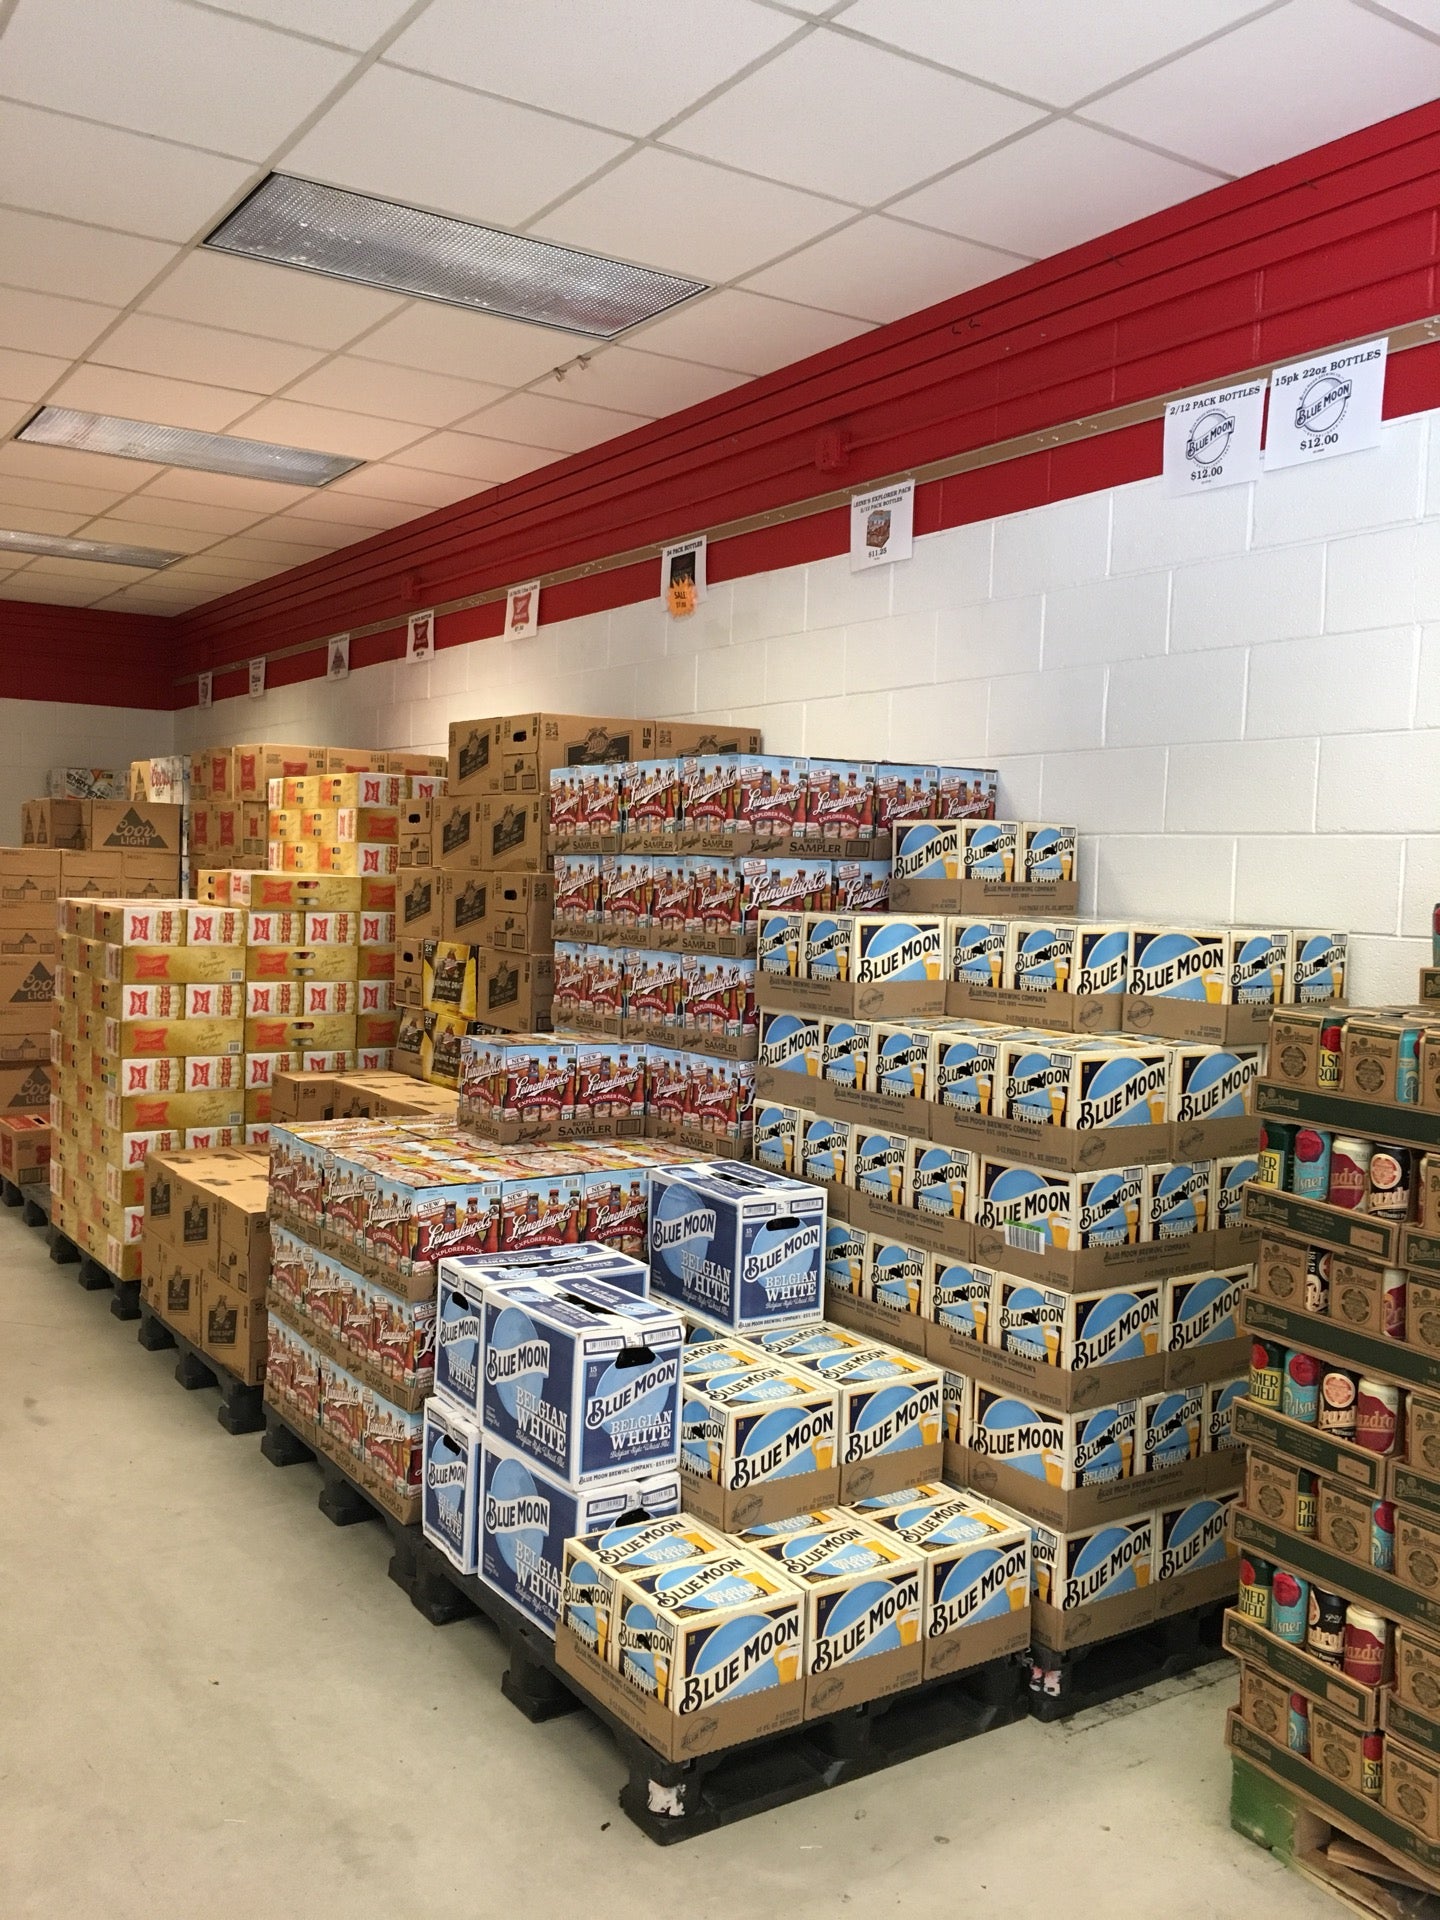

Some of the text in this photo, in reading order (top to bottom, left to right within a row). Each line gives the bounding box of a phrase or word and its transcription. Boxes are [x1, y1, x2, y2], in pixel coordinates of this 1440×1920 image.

[1275, 373, 1299, 387] 15pk
[1302, 365, 1327, 380] 22oz
[1330, 349, 1381, 371] BOTTLES
[1169, 386, 1261, 415] 2/12 PACK BOTTLES
[1296, 403, 1322, 427] BLUE
[1323, 383, 1350, 409] MOON
[1187, 420, 1234, 459] BLUE MOON
[1300, 433, 1339, 451] $12.00
[1190, 466, 1223, 481] $12.00
[870, 502, 882, 510] PACK
[882, 496, 902, 506] BOTTLES
[872, 492, 898, 503] EXPLORER
[898, 486, 912, 496] PACK
[674, 590, 687, 600] SALE
[546, 728, 559, 736] 24
[744, 785, 800, 812] Leinenkugel's
[113, 818, 158, 837] Coors
[750, 812, 792, 822] EXPLORER PACK
[120, 836, 151, 846] LIGHT
[643, 840, 673, 849] SAMPLER
[702, 840, 733, 849] SAMPLER
[789, 842, 841, 853] SAMPLER
[894, 834, 958, 880] BLUE MOON
[745, 870, 826, 911] Leinenkugel's
[425, 944, 432, 952] 24
[620, 932, 646, 942] SAMPLER
[682, 939, 716, 950] SAMPLER
[857, 933, 941, 983] BLUE MOON
[1130, 948, 1224, 995] BLUE MOON
[20, 974, 54, 992] Coo
[28, 991, 53, 1000] LIGH
[582, 1054, 597, 1063] NEW
[704, 1040, 736, 1052] SAMPLER
[760, 1030, 819, 1066] BLUE MOON
[511, 1056, 526, 1065] NEW
[303, 1088, 316, 1096] 24
[511, 1071, 570, 1100] Leinenkugel's
[582, 1067, 638, 1097] Leinenkugel's
[1178, 1061, 1258, 1122] BLUE MOON
[517, 1096, 562, 1108] EXPLORER PACK
[589, 1094, 632, 1104] EXPLORER PACK
[1077, 1066, 1166, 1130] BLUE MOON
[558, 1124, 611, 1136] SAMPLER
[680, 1136, 714, 1150] SAMPLER
[506, 1192, 522, 1200] NEW
[592, 1182, 607, 1192] NEW
[422, 1199, 440, 1208] NEW
[976, 1192, 1070, 1230] BLUE MOON
[422, 1212, 492, 1252] Leinenkugel's
[506, 1203, 572, 1243] Leinenkugel's
[598, 1226, 644, 1240] EXPLORER PACK
[653, 1213, 716, 1248] BLUE MOON
[430, 1246, 485, 1260] EXPLORER PACK
[514, 1236, 564, 1250] EXPLORER PACK
[744, 1229, 818, 1280] BLUE MOON
[682, 1250, 731, 1286] BELGIAN
[766, 1270, 818, 1287] BELGIAN
[682, 1266, 730, 1306] WHITE
[765, 1283, 817, 1302] WHITE
[1169, 1282, 1250, 1352] BLUE MOON
[440, 1318, 479, 1346] BLUE MOON
[766, 1326, 832, 1354] BLUE MOON
[1007, 1334, 1043, 1351] BELGIAN
[1071, 1298, 1158, 1372] BLUE MOON
[689, 1342, 729, 1358] MOON
[448, 1351, 477, 1378] BELGIAN
[448, 1363, 476, 1392] WHITE
[486, 1346, 548, 1385] BLUE MOON
[590, 1366, 598, 1374] 15
[823, 1349, 888, 1380] BLUE MOON
[708, 1368, 784, 1402] BLUE MOON
[1251, 1371, 1279, 1388] SNER
[516, 1385, 568, 1432] BELGIAN
[587, 1364, 676, 1429] BLUE MOON
[1282, 1397, 1317, 1416] Pilsne
[516, 1404, 567, 1457] WHITE
[610, 1410, 672, 1434] BELGIAN
[846, 1388, 939, 1464] BLUE MOON
[610, 1425, 672, 1451] WHITE
[731, 1410, 834, 1491] BLUE MOON
[969, 1426, 1064, 1456] BLUE MOON
[428, 1462, 466, 1489] BLUE MOON
[579, 1475, 592, 1485] BLUE
[594, 1472, 608, 1480] MOON
[608, 1468, 630, 1477] BREWING
[439, 1507, 462, 1540] WHITE
[486, 1498, 548, 1532] BLUE MOON
[902, 1500, 970, 1544] BLUE MOON
[600, 1520, 686, 1566] BLUE MOON
[787, 1528, 864, 1574] BLUE MOON
[1062, 1526, 1152, 1611] BLUE MOON
[657, 1558, 746, 1608] BLUE MOON
[929, 1550, 1026, 1638] BLUE MOON
[1240, 1588, 1266, 1606] SNER
[812, 1581, 919, 1675] BLUE MOON
[679, 1615, 800, 1716] BLUE MOON
